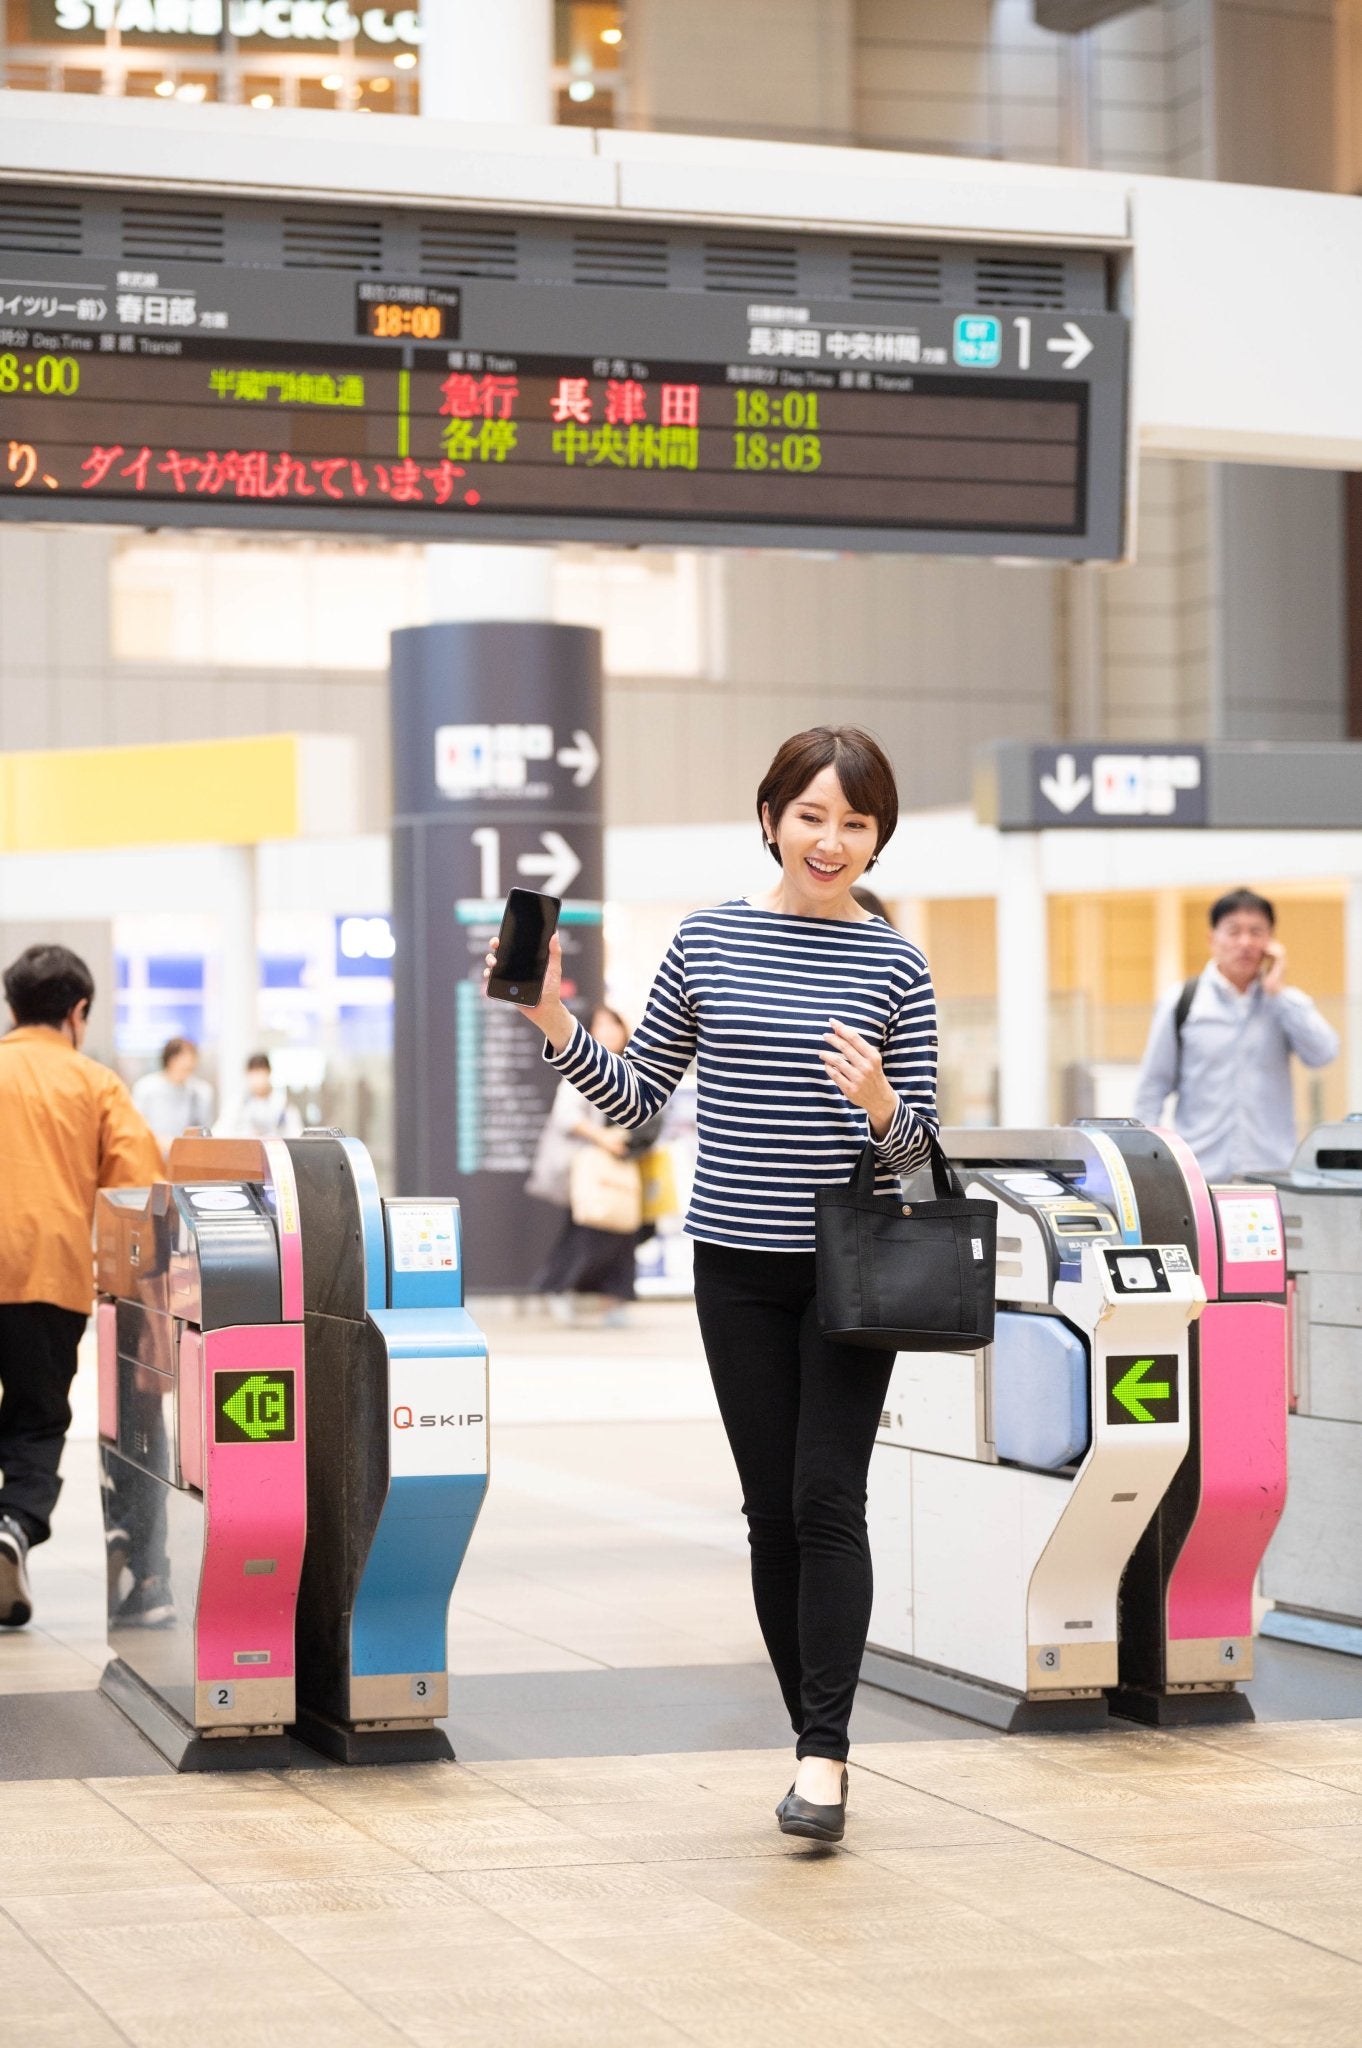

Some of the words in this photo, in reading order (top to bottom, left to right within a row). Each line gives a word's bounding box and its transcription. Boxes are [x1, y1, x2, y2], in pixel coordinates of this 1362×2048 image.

[117, 295, 197, 326] 春日部
[373, 304, 442, 338] 18:00
[749, 327, 821, 358] 長津田
[826, 331, 921, 363] 中央林間
[1013, 316, 1031, 370] 1
[438, 372, 520, 420] 急行
[734, 388, 821, 431] 18:01
[440, 416, 519, 462] 各停
[551, 420, 699, 470] 中央林間
[733, 431, 823, 473] 18:03
[471, 826, 500, 899] 1
[1163, 1249, 1188, 1262] QR
[245, 1391, 280, 1423] IC
[394, 1406, 414, 1429] Q
[420, 1414, 483, 1427] SKIP
[1045, 1652, 1056, 1666] 3
[1224, 1646, 1235, 1660] 4
[218, 1690, 228, 1704] 2
[416, 1681, 427, 1696] 3
